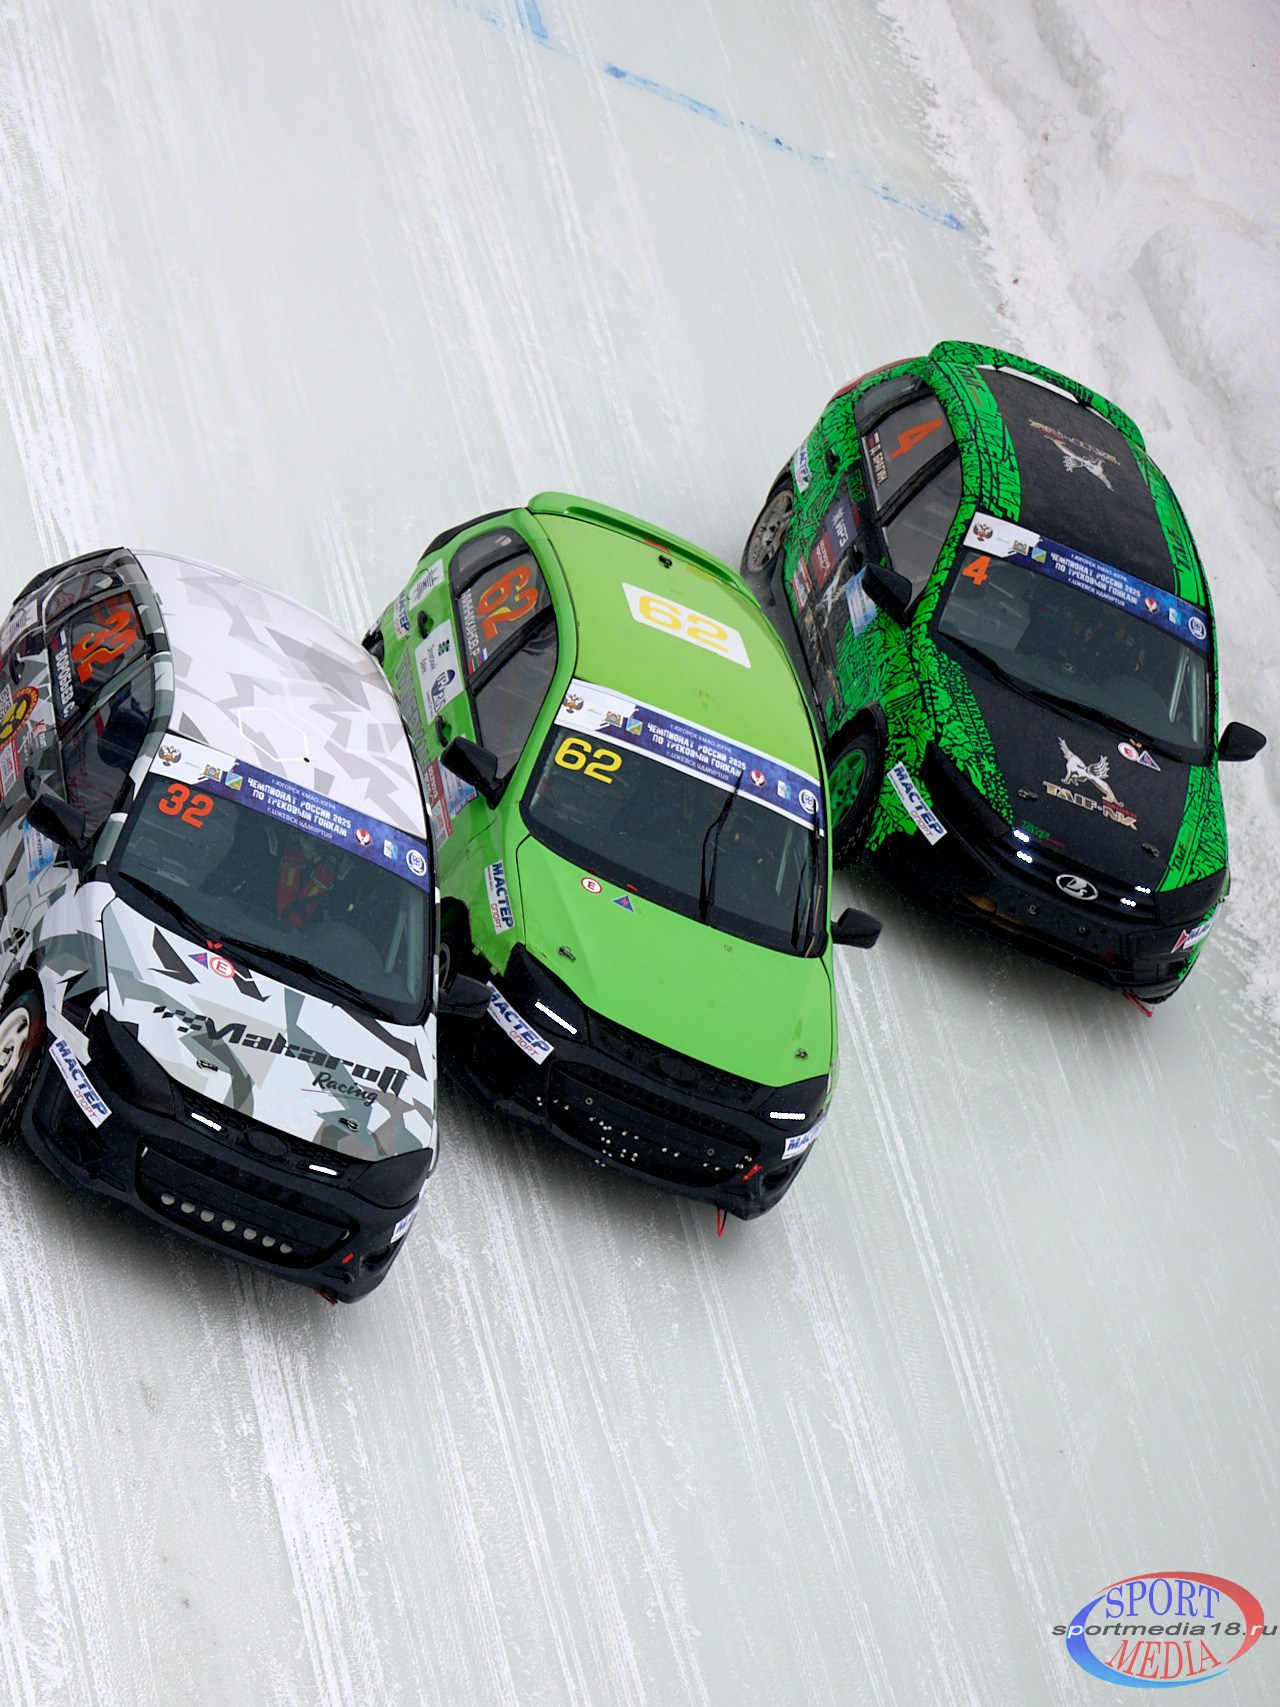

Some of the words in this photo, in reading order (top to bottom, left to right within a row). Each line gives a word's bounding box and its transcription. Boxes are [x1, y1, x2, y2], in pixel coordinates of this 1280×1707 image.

[890, 418, 944, 459] 4
[961, 555, 991, 586] 4
[476, 565, 539, 641] 62
[638, 595, 728, 653] 62
[71, 609, 137, 684] 32
[646, 723, 694, 749] ЧЕМПИОНАТ
[697, 744, 727, 763] РОССИИ
[728, 756, 747, 771] 2025
[956, 701, 982, 753] HERITAGE
[964, 693, 995, 754] TATARSTAN
[554, 737, 623, 785] 62
[651, 734, 664, 745] ПО
[666, 740, 710, 765] ТРЕКОВЫМ
[711, 758, 743, 778] ГОНКАМ
[158, 783, 214, 829] 32
[247, 777, 297, 804] ЧЕМПИОНАТ
[300, 800, 331, 819] РОССИИ
[333, 813, 351, 828] 2025
[252, 789, 265, 800] ПО
[267, 795, 312, 821] ТРЕКОВЫМ
[313, 815, 347, 837] ГОНКАМ
[893, 765, 945, 836] МАСТЕР
[909, 810, 933, 838] СПОРТ
[490, 903, 502, 929] СПОРТ
[492, 862, 514, 929] МАСТЕР
[509, 1030, 539, 1057] СПОРТ
[55, 1040, 108, 1115] МАСТЕР
[312, 1072, 378, 1107] Racing
[74, 1089, 97, 1118] СПОРТ
